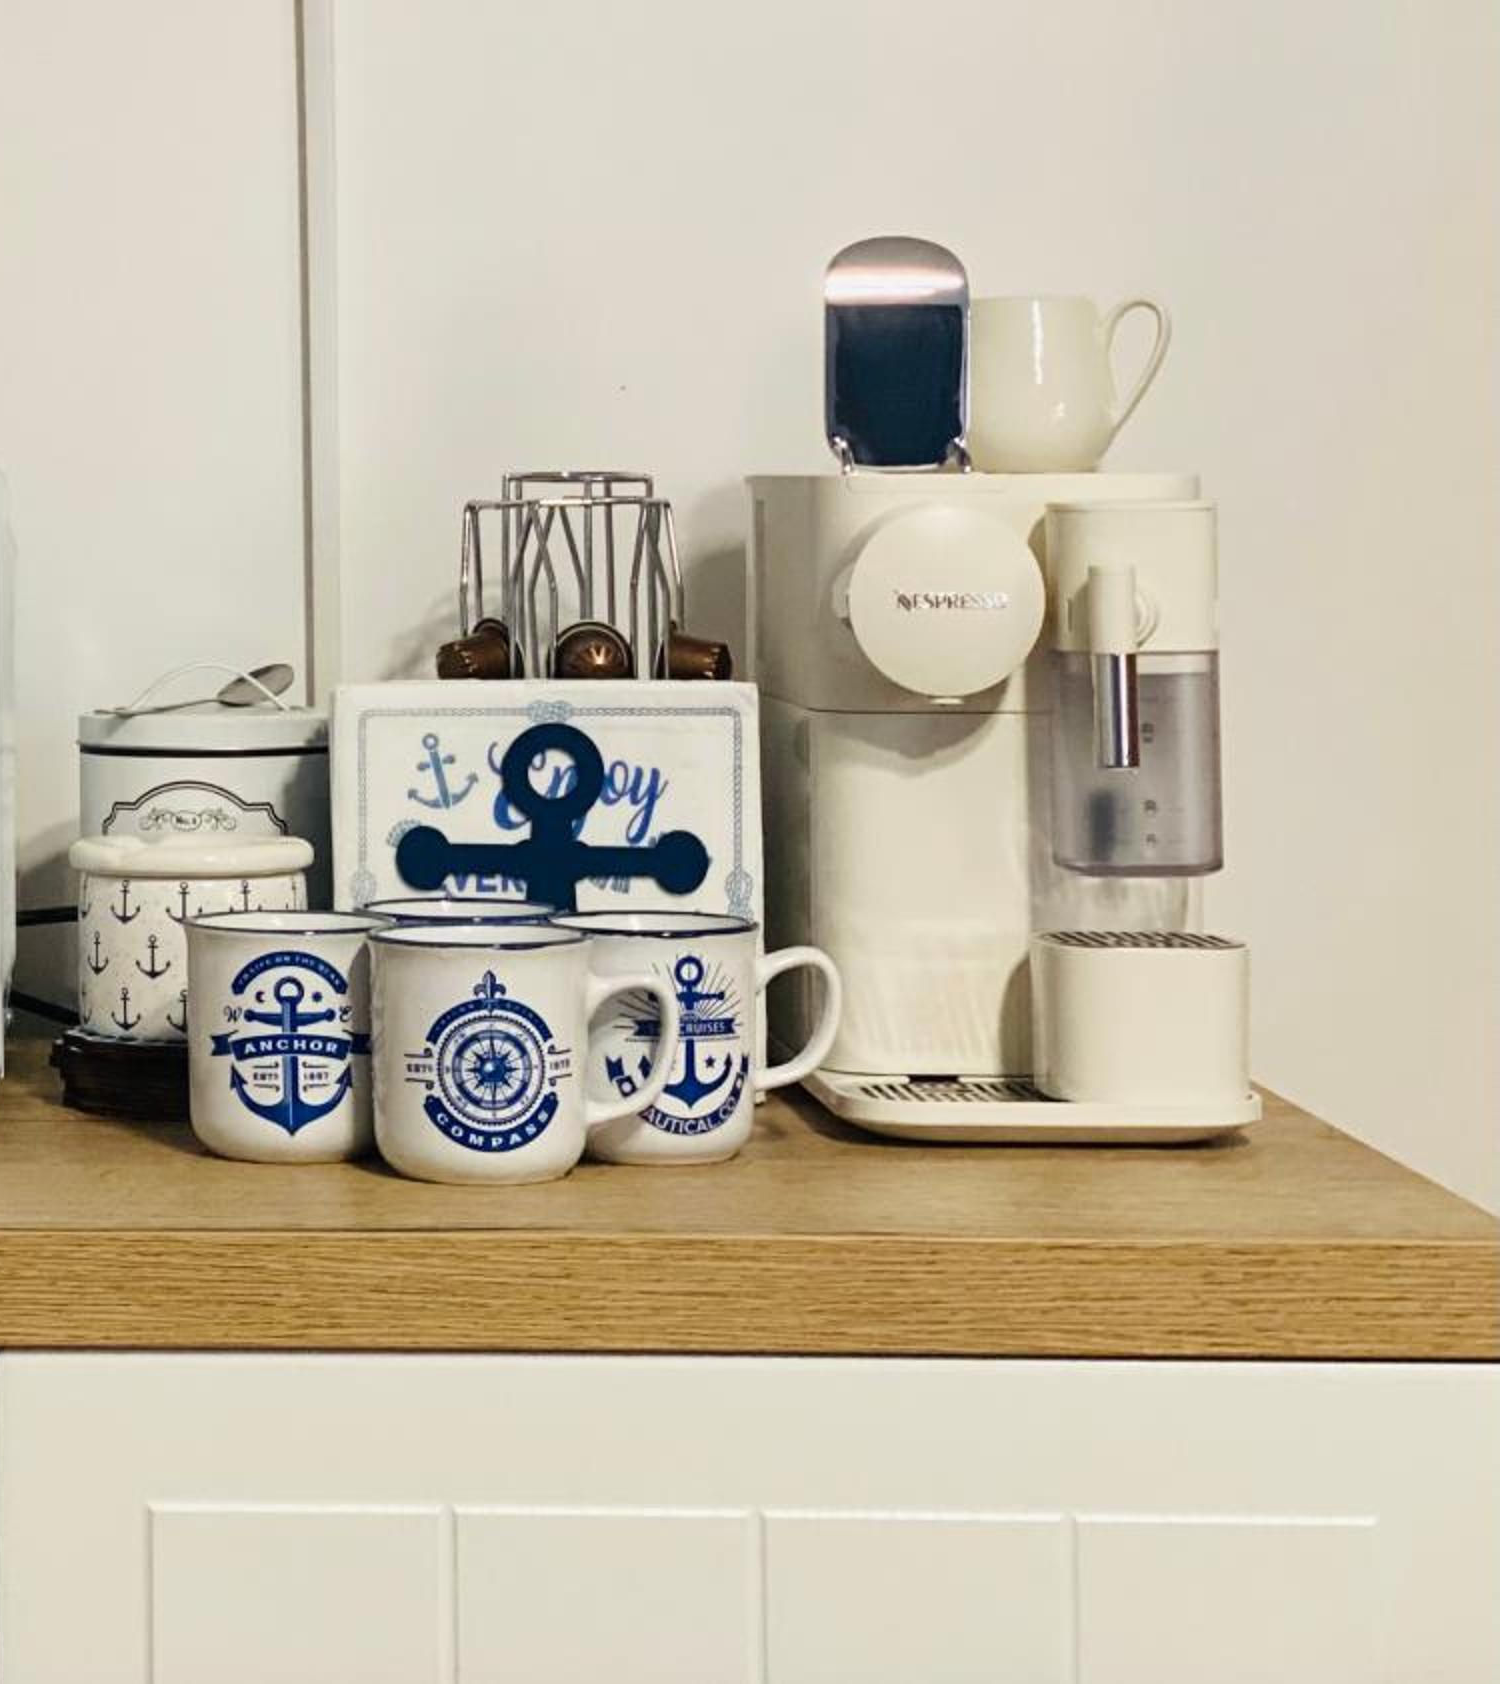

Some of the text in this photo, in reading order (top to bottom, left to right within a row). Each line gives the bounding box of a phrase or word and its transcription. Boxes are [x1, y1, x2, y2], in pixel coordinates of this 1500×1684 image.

[243, 1038, 339, 1055] ANCHOR
[436, 1110, 550, 1148] COMPASS
[641, 1105, 718, 1136] AUTICAL
